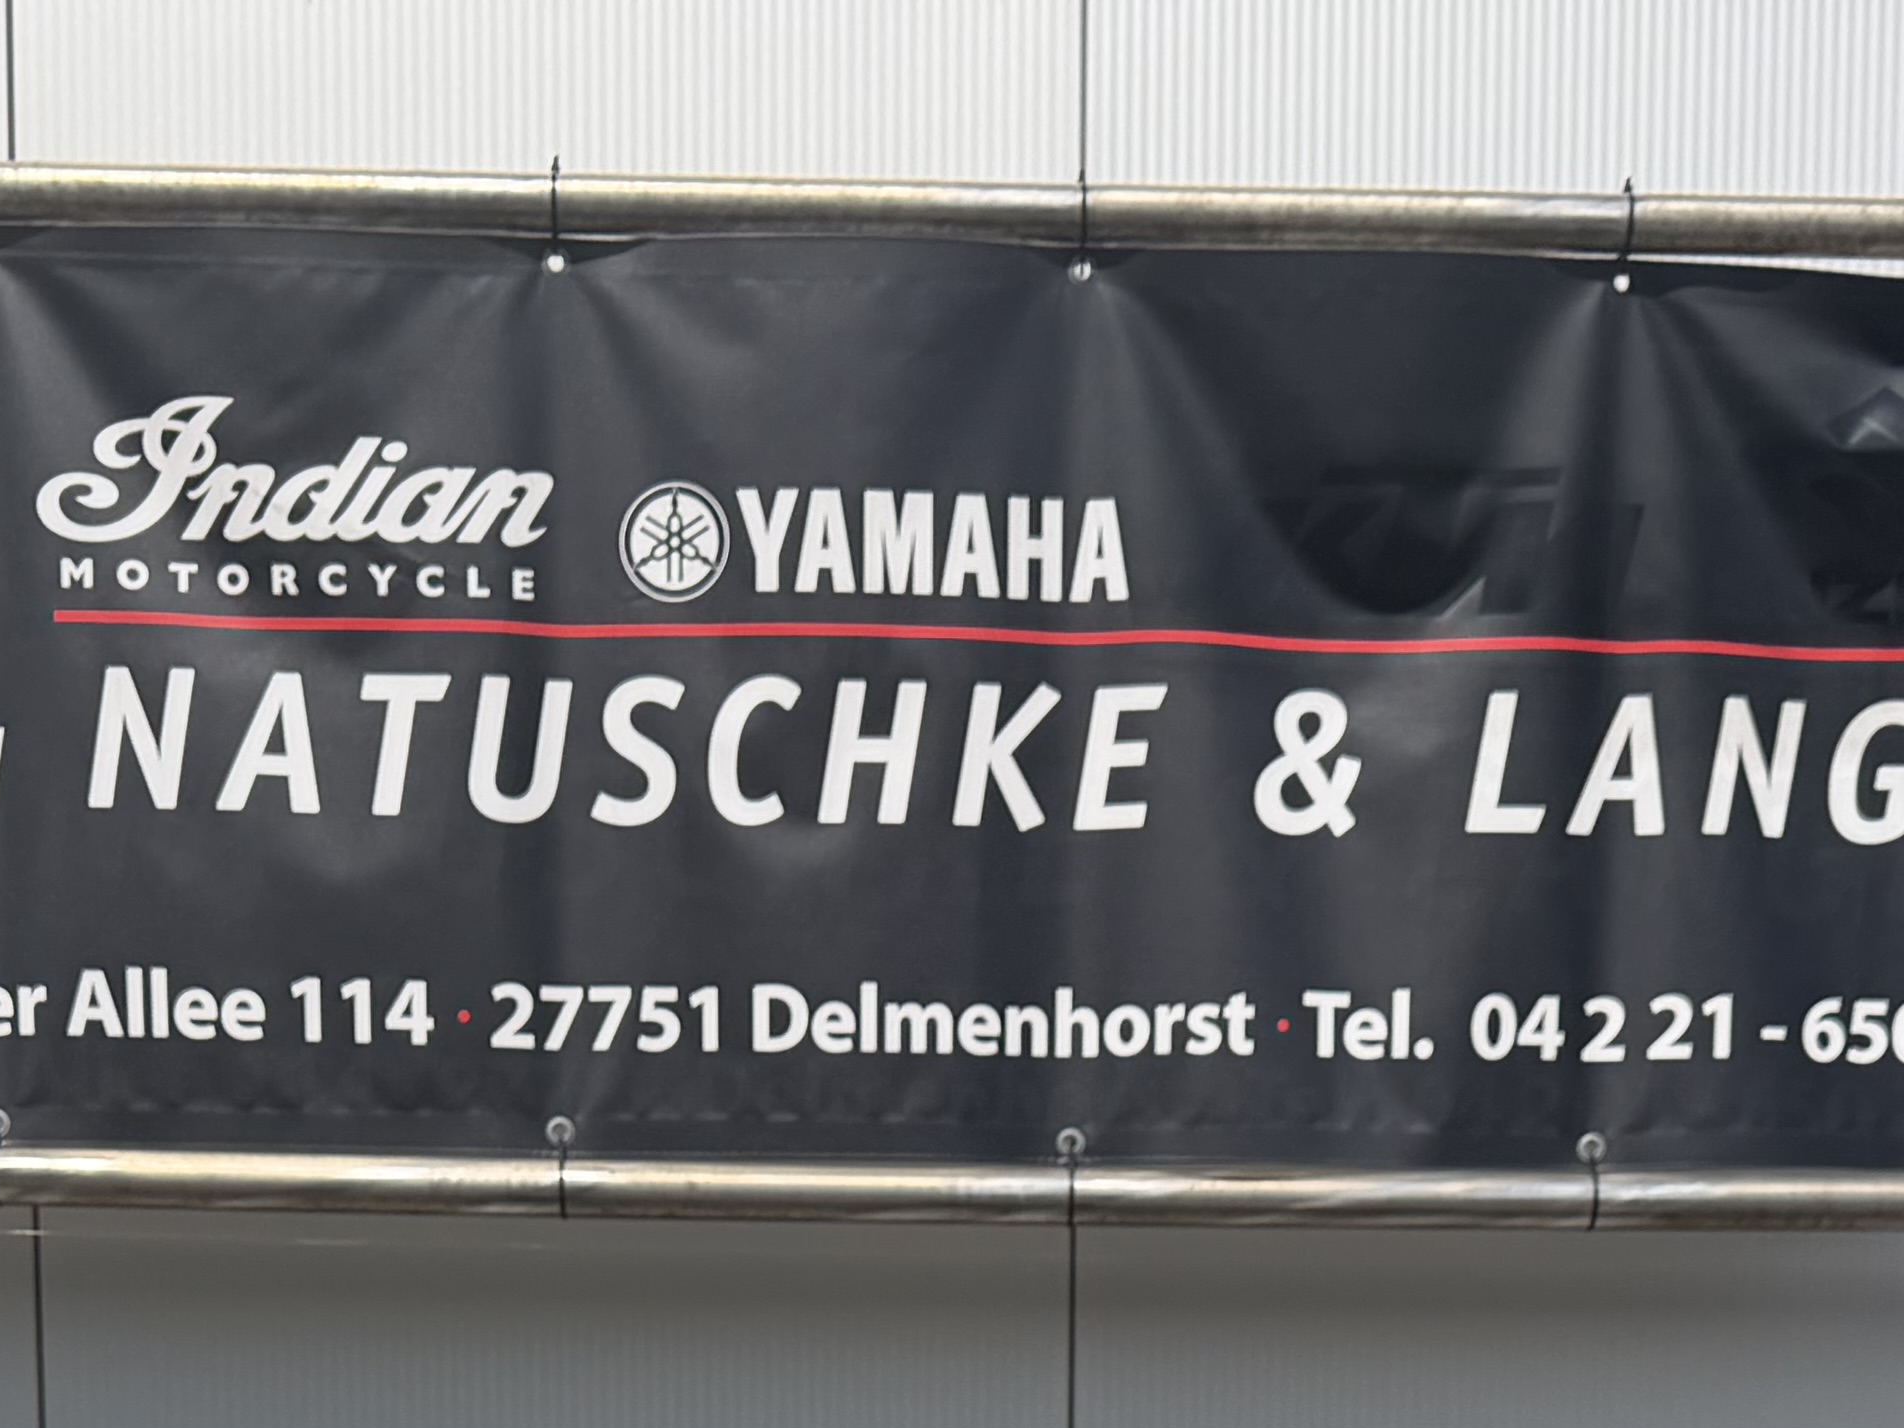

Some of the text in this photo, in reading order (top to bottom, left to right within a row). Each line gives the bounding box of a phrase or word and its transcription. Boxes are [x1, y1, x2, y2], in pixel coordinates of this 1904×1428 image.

[35, 395, 555, 548] Indian
[59, 556, 535, 602] MOTORCYCLE
[735, 486, 1130, 604] YAMAHA
[87, 664, 1169, 833] NATUSCHKE
[1253, 688, 1377, 839] &
[66, 965, 267, 1042] Allee
[290, 976, 435, 1046] 114
[489, 981, 720, 1053] 27751
[751, 980, 1256, 1059] Delmenhorst
[1301, 987, 1435, 1061] Tel.
